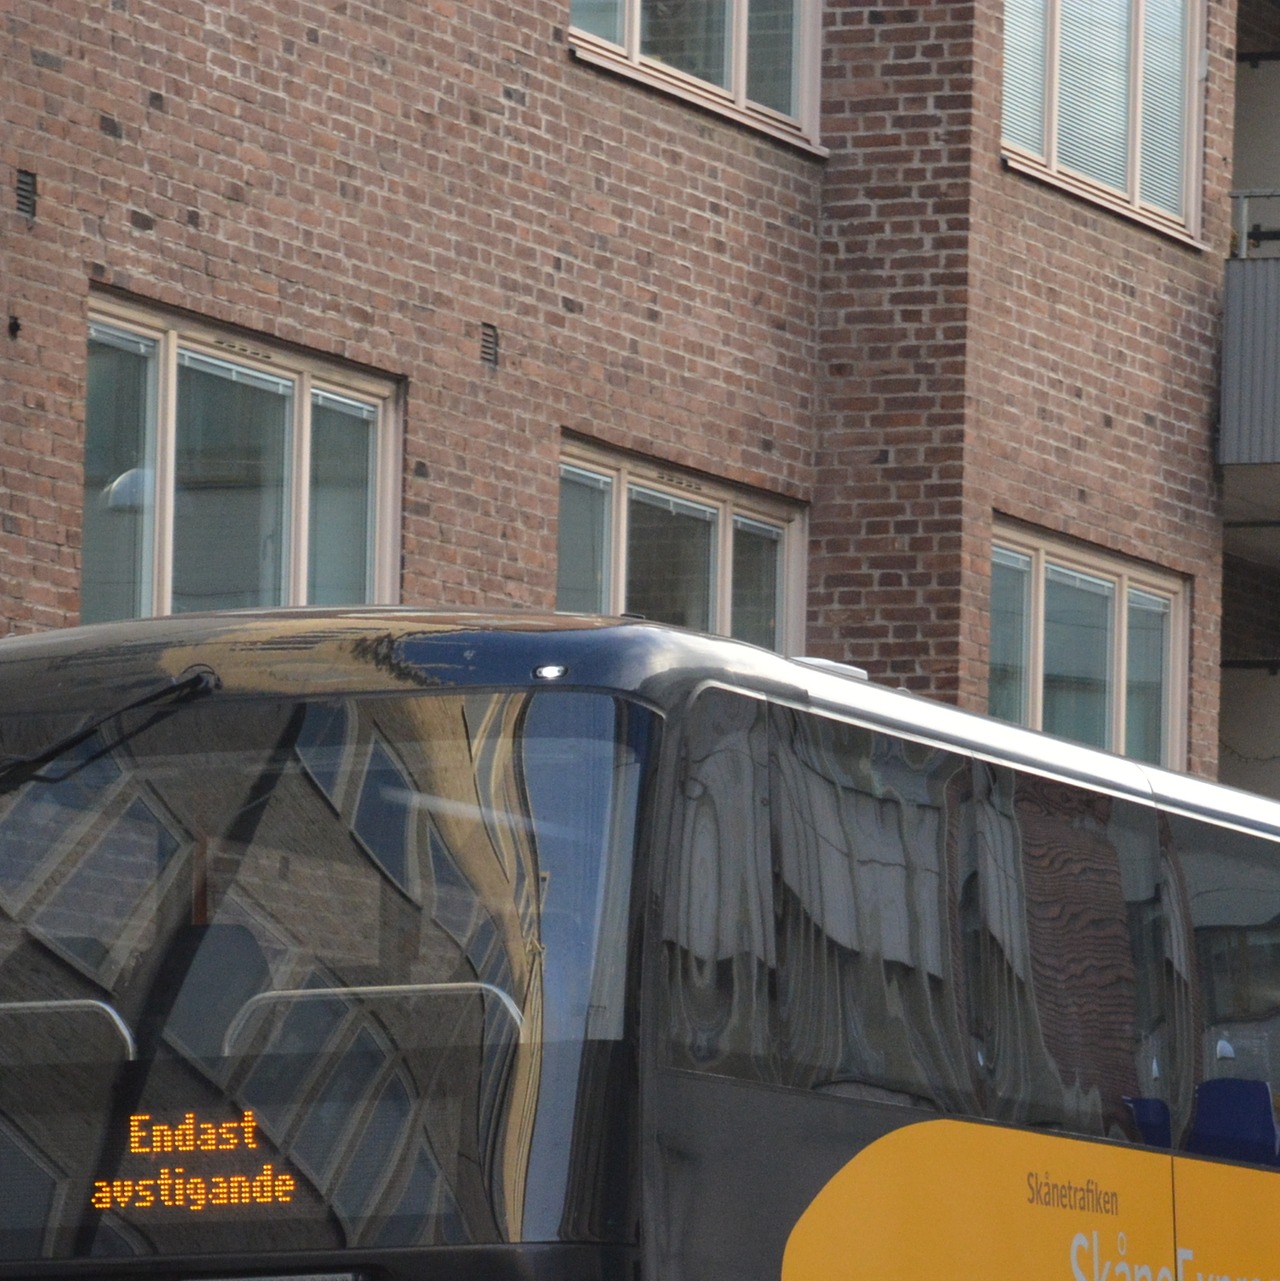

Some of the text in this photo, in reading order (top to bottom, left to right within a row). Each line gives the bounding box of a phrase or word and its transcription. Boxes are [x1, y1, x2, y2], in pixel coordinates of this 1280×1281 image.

[129, 1110, 259, 1154] Endast
[91, 1164, 297, 1211] avstigande
[1026, 1171, 1119, 1217] Skånetrafiken
